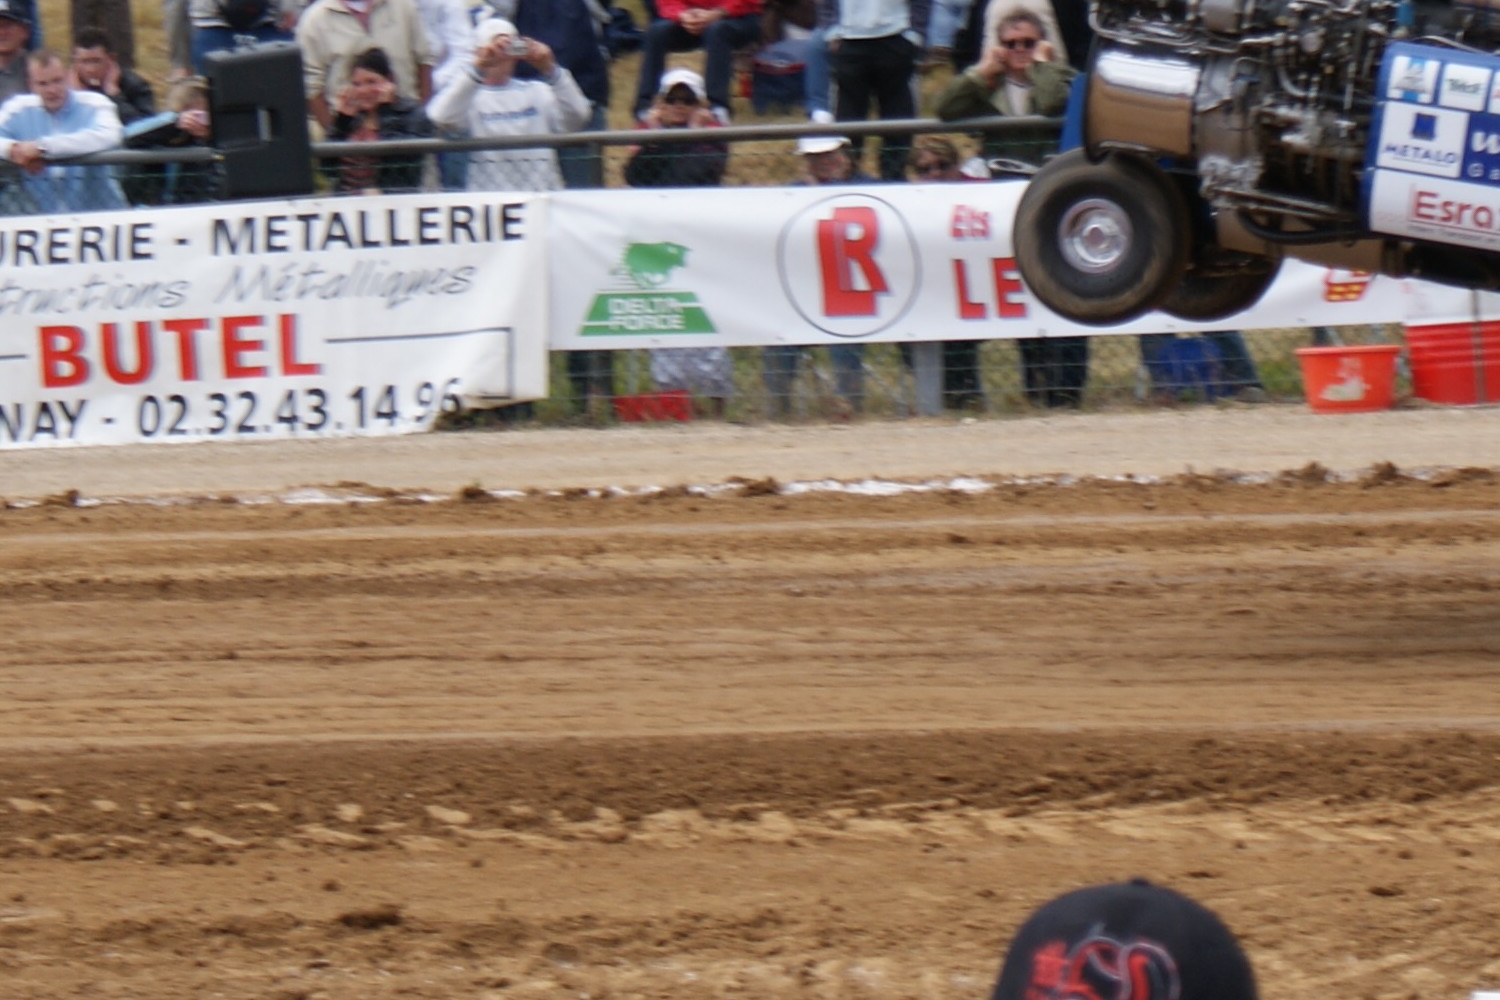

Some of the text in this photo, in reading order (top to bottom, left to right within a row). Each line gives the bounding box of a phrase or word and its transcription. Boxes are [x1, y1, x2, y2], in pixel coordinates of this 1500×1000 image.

[213, 202, 524, 257] METALLERIE
[1413, 191, 1492, 227] Esra
[37, 313, 321, 388] BUTEL
